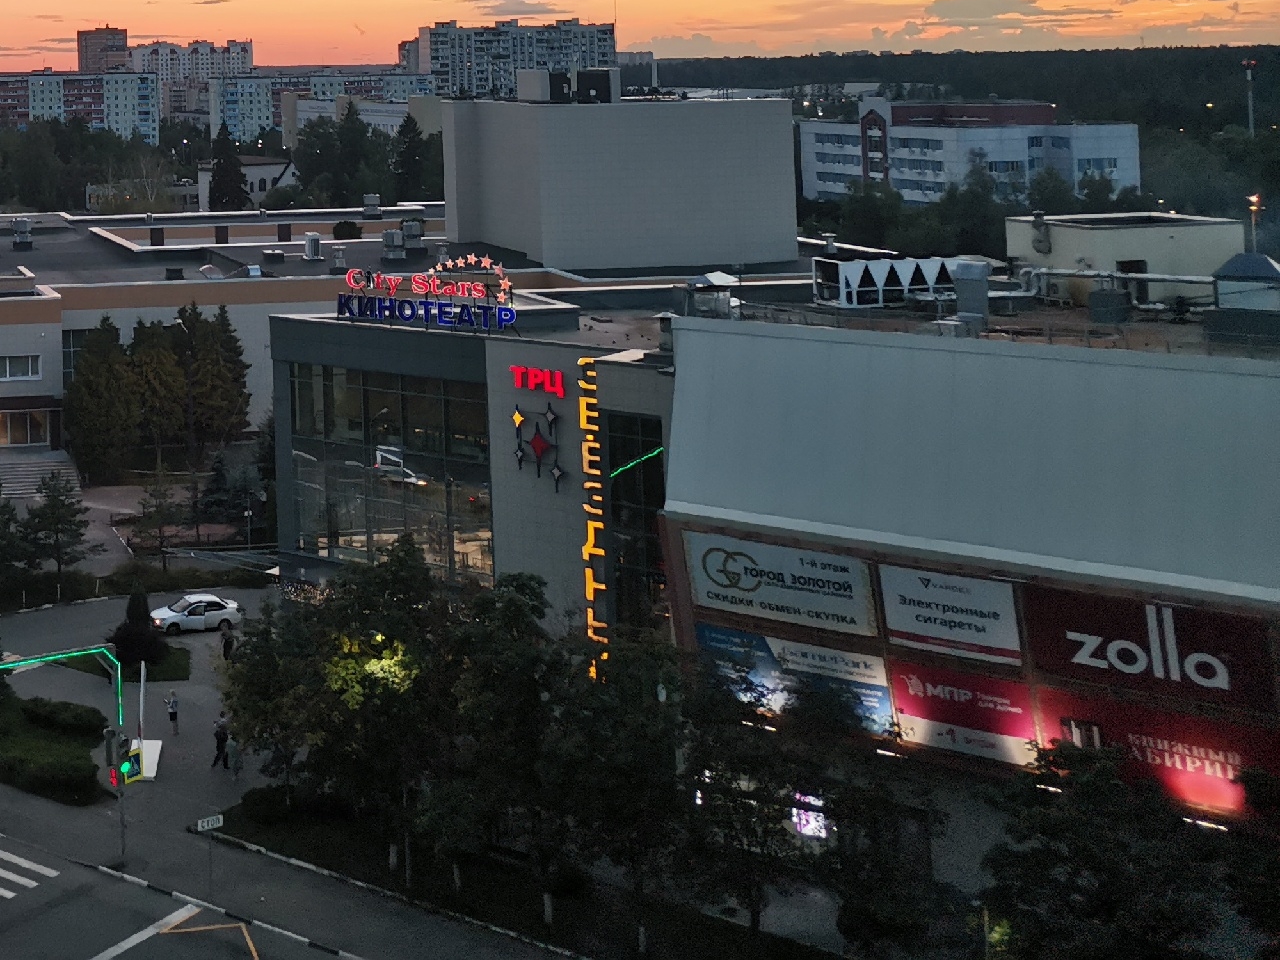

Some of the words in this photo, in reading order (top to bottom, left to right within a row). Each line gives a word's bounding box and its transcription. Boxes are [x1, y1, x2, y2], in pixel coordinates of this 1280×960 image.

[345, 268, 403, 297] City
[411, 273, 487, 299] Stars
[337, 293, 518, 330] КИНОТЕАТР
[509, 365, 565, 399] ТРЦ
[743, 566, 785, 584] ГОРОД
[790, 573, 853, 594] ЗОЛОТОЙ
[820, 563, 850, 574] этаж
[706, 591, 754, 608] СКИДКИ
[759, 601, 802, 617] ОБМЕН
[807, 610, 858, 626] СКУПКА
[898, 594, 1001, 621] Электронные
[915, 613, 987, 634] сигареты
[1065, 604, 1231, 691] zolla
[925, 683, 973, 703] МПР
[1128, 746, 1242, 781] АБИРИ
[201, 816, 220, 829] СТОП
